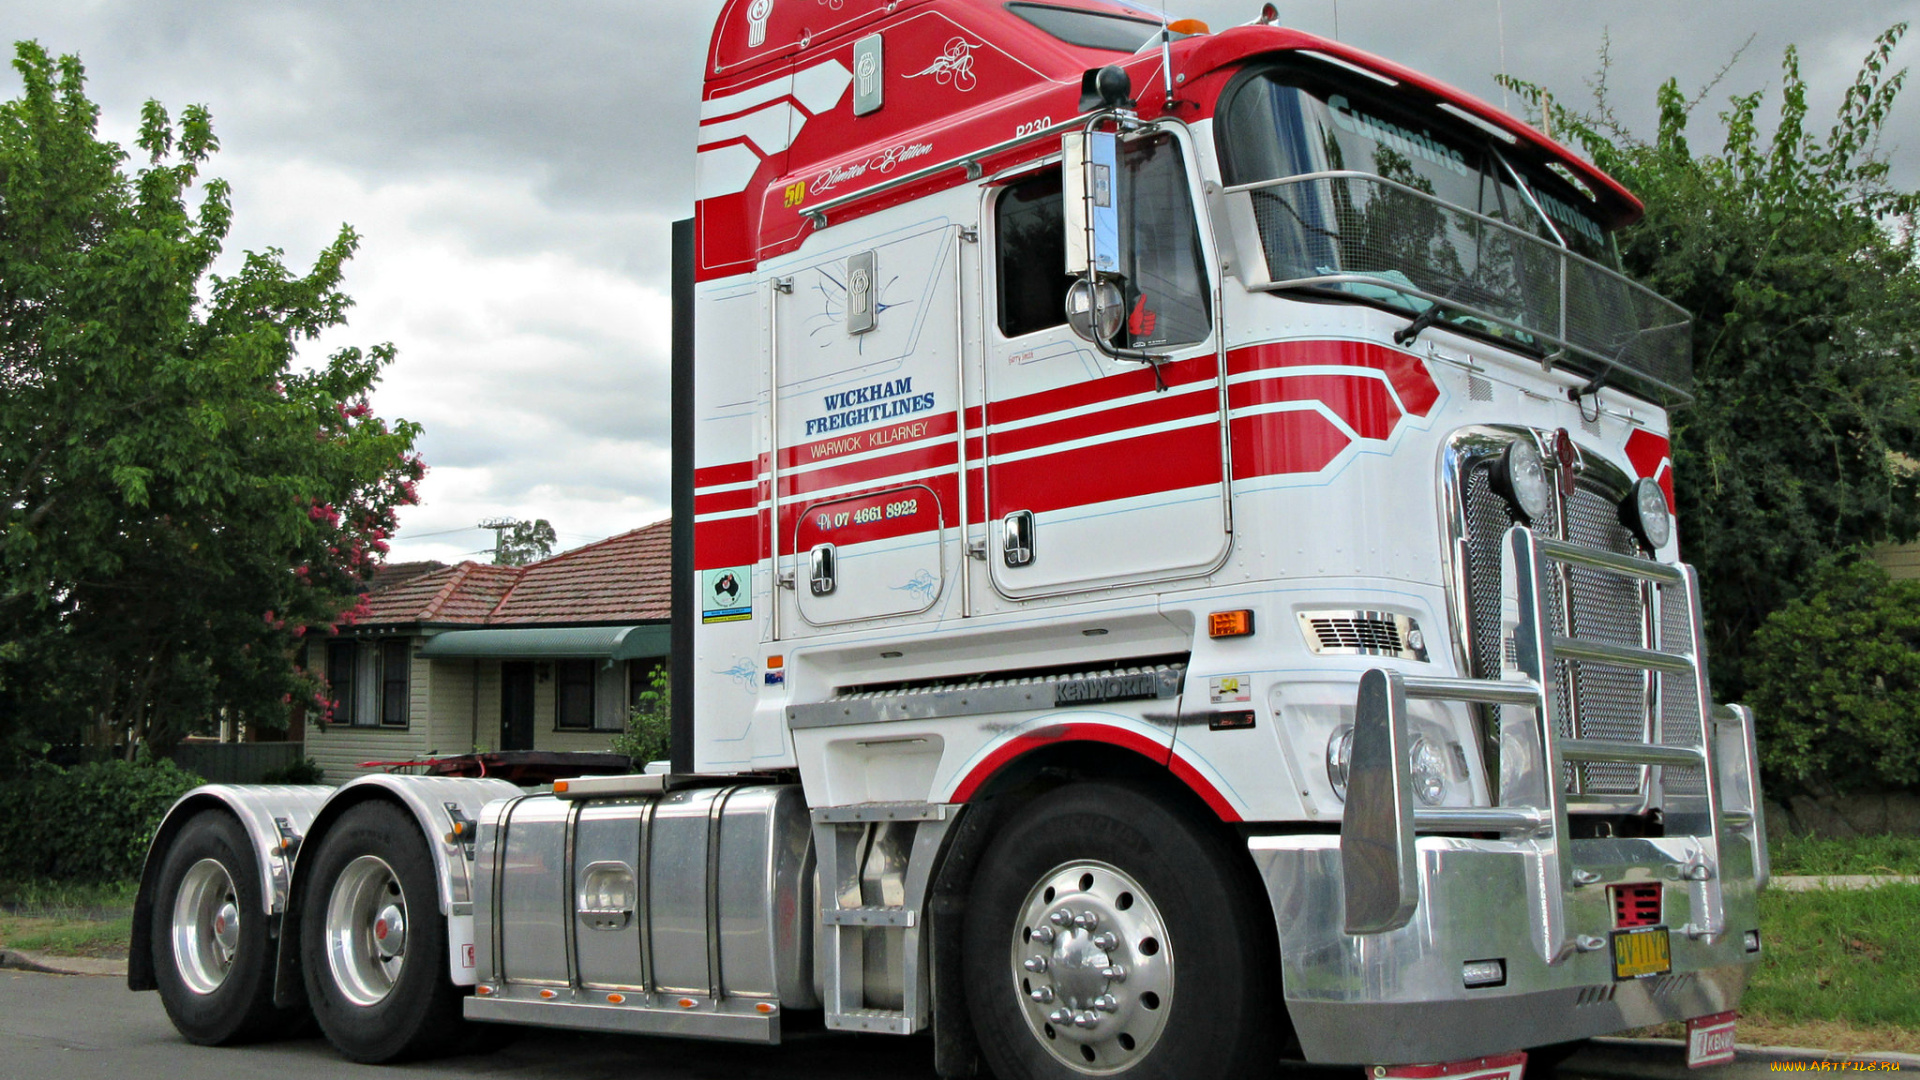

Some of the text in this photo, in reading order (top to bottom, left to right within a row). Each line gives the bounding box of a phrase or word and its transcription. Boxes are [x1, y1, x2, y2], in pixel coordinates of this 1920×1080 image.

[1328, 95, 1467, 175] Cummins
[784, 142, 933, 208] 50 Limited Edition
[824, 376, 912, 412] WICKHAM
[805, 392, 935, 436] FREIGHTLINES
[810, 421, 928, 459] WARWICK KILLARNEY
[834, 512, 850, 528] 07
[853, 506, 882, 524] 4661
[886, 499, 918, 519] 8922
[1055, 675, 1156, 701] KENWORTH
